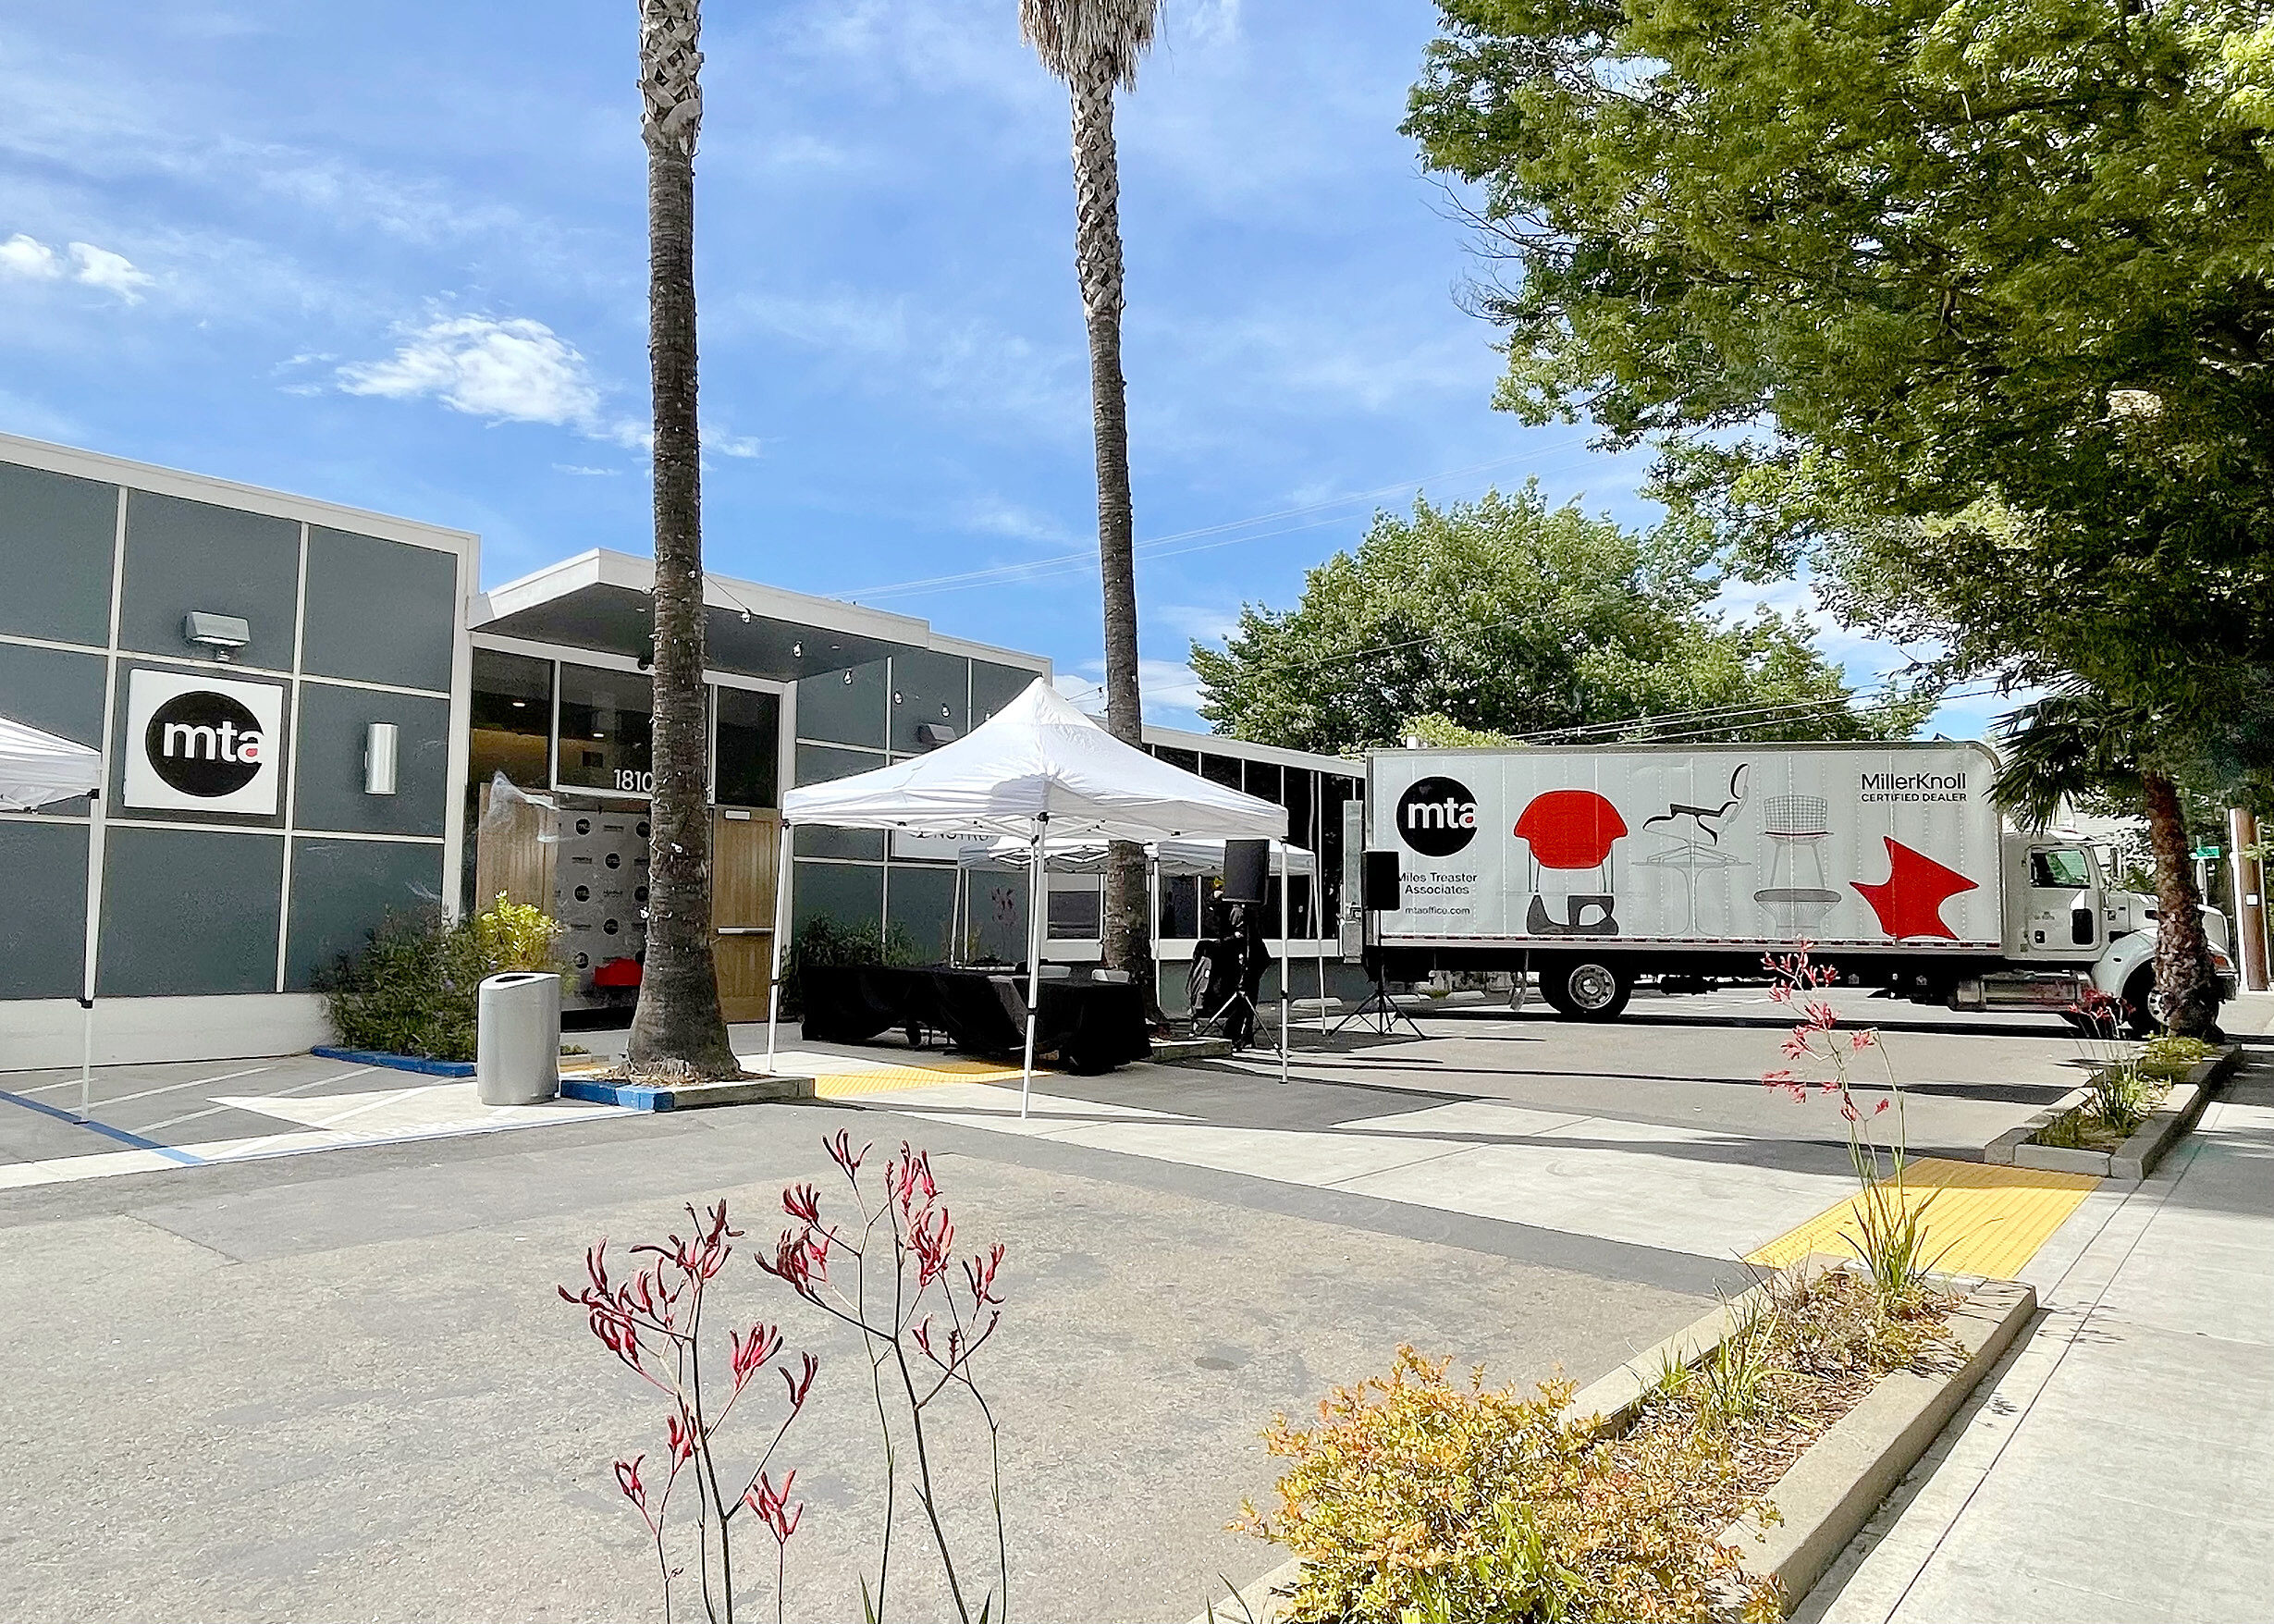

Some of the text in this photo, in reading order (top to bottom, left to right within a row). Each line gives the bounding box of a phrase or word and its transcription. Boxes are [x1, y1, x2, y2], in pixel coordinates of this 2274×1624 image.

[163, 720, 264, 764] mta
[614, 769, 653, 793] 1810
[1862, 772, 1966, 790] MillerKnoll
[1862, 794, 1967, 802] CERTIFIED DEALER
[1407, 797, 1478, 829] mta
[1430, 872, 1478, 883] Treaster
[1405, 884, 1470, 894] Associates
[1405, 906, 1470, 915] mtaoffice.com
